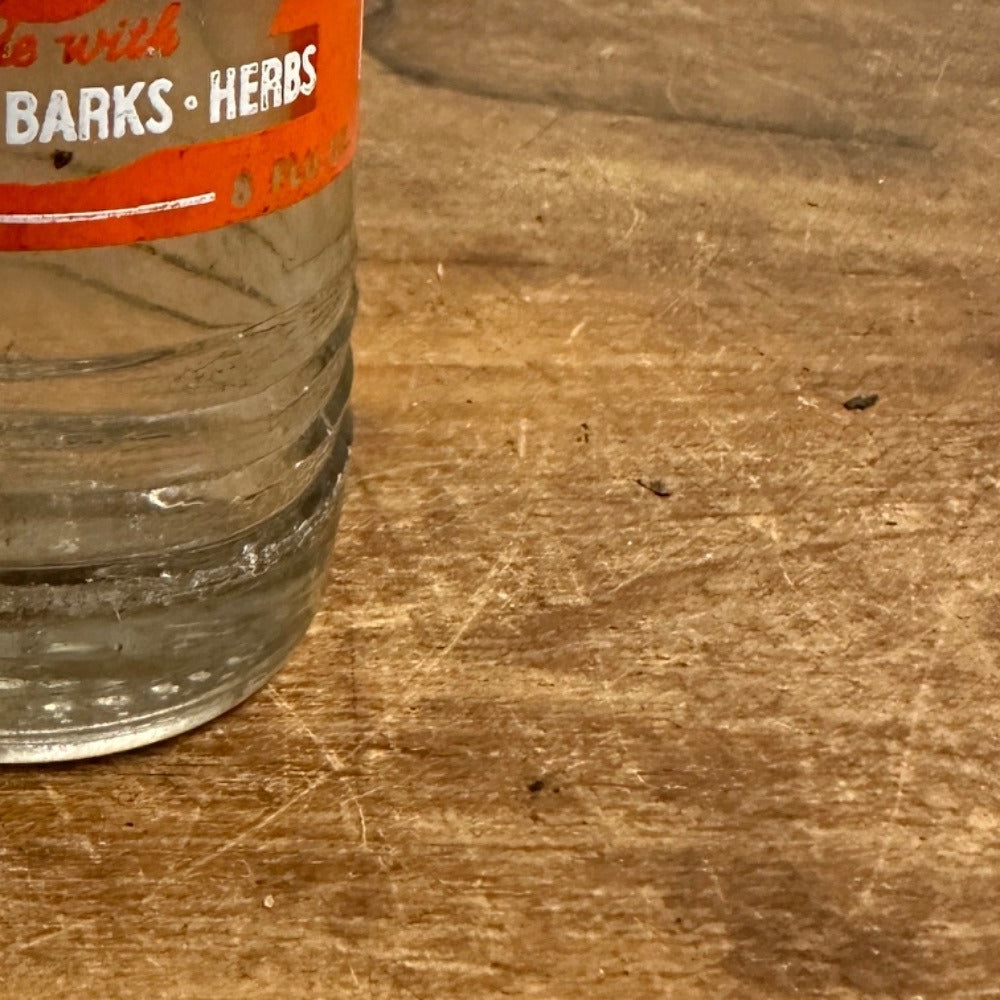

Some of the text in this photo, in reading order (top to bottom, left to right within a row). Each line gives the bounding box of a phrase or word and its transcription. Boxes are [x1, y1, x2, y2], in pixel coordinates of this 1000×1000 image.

[56, 1, 182, 66] with
[5, 77, 174, 145] BARKS
[209, 43, 317, 124] HERBS
